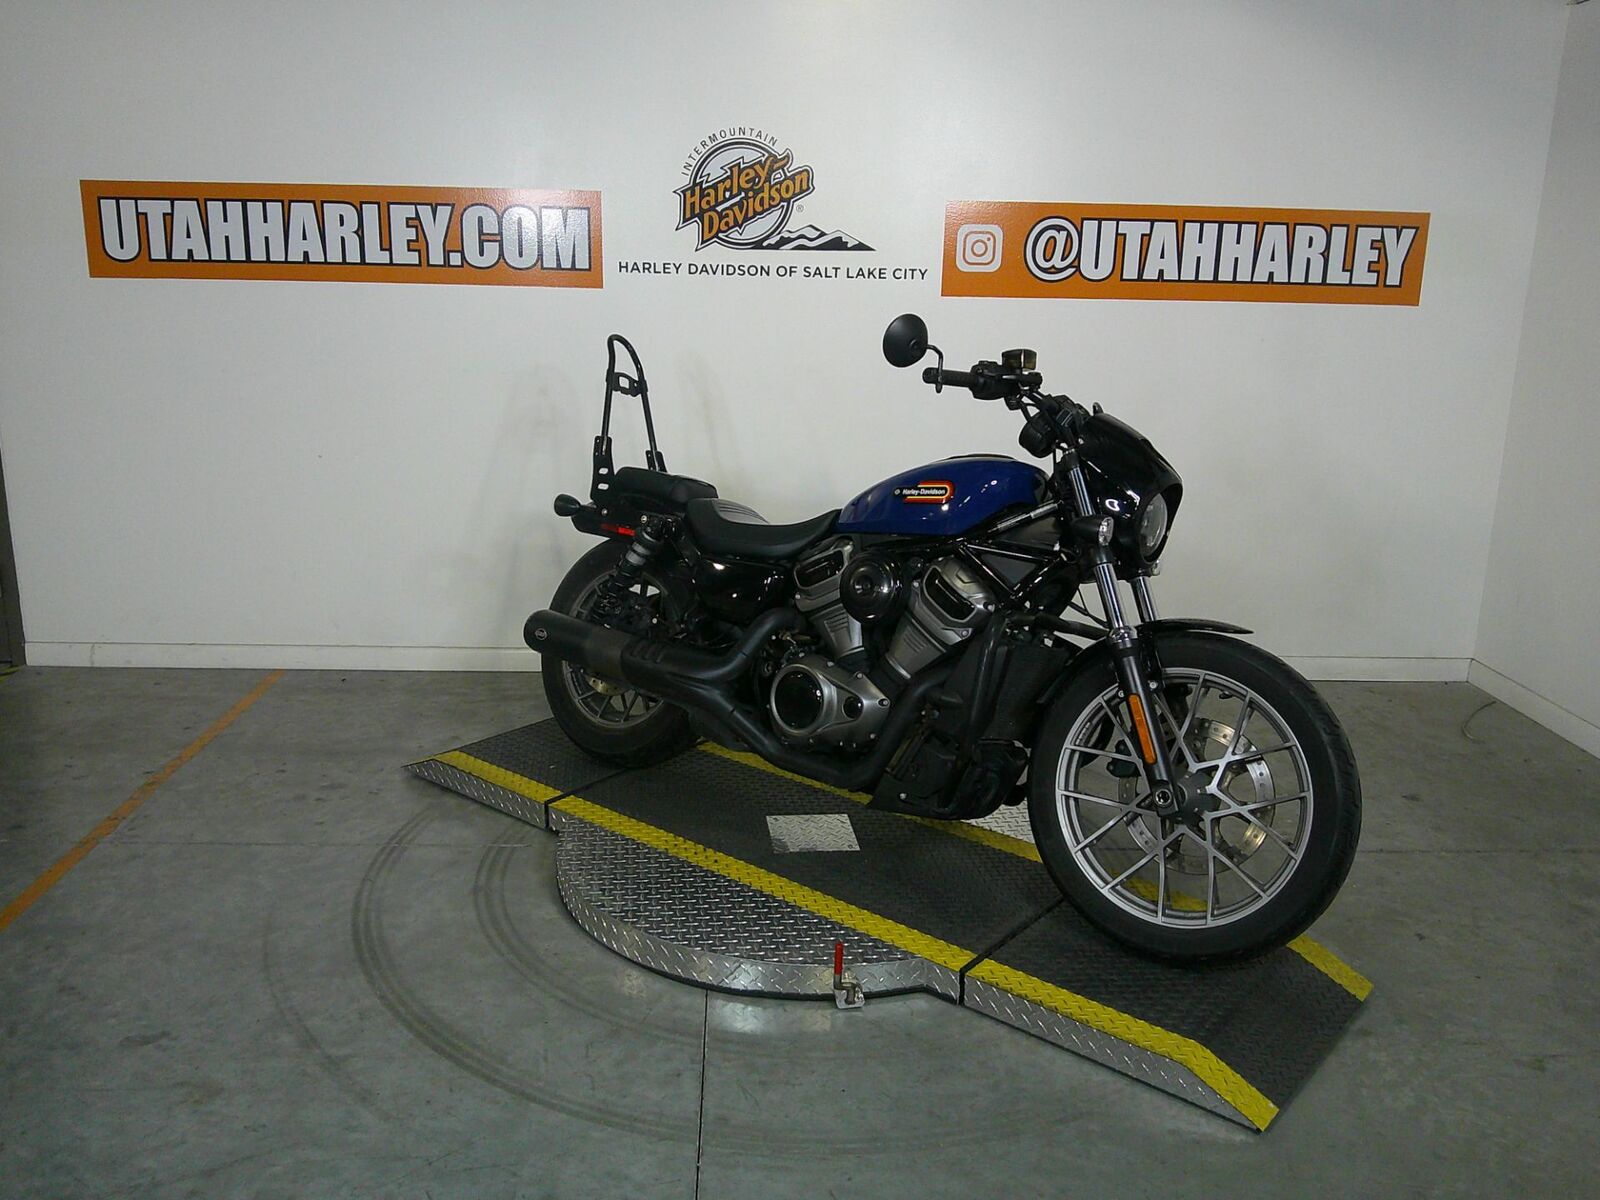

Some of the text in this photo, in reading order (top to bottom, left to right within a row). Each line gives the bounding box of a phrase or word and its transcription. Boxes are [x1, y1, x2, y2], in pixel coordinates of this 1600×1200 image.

[681, 126, 778, 177] INTERMOUNTAIN
[98, 196, 592, 271] UTAHHARLEY.COM
[702, 168, 810, 242] Davidson
[618, 261, 928, 280] HARLEY DAVIDSON OF SALT LAKE CITY
[1023, 215, 1418, 288] @UTAHHARLEY
[902, 488, 945, 496] Harley-Davidson
